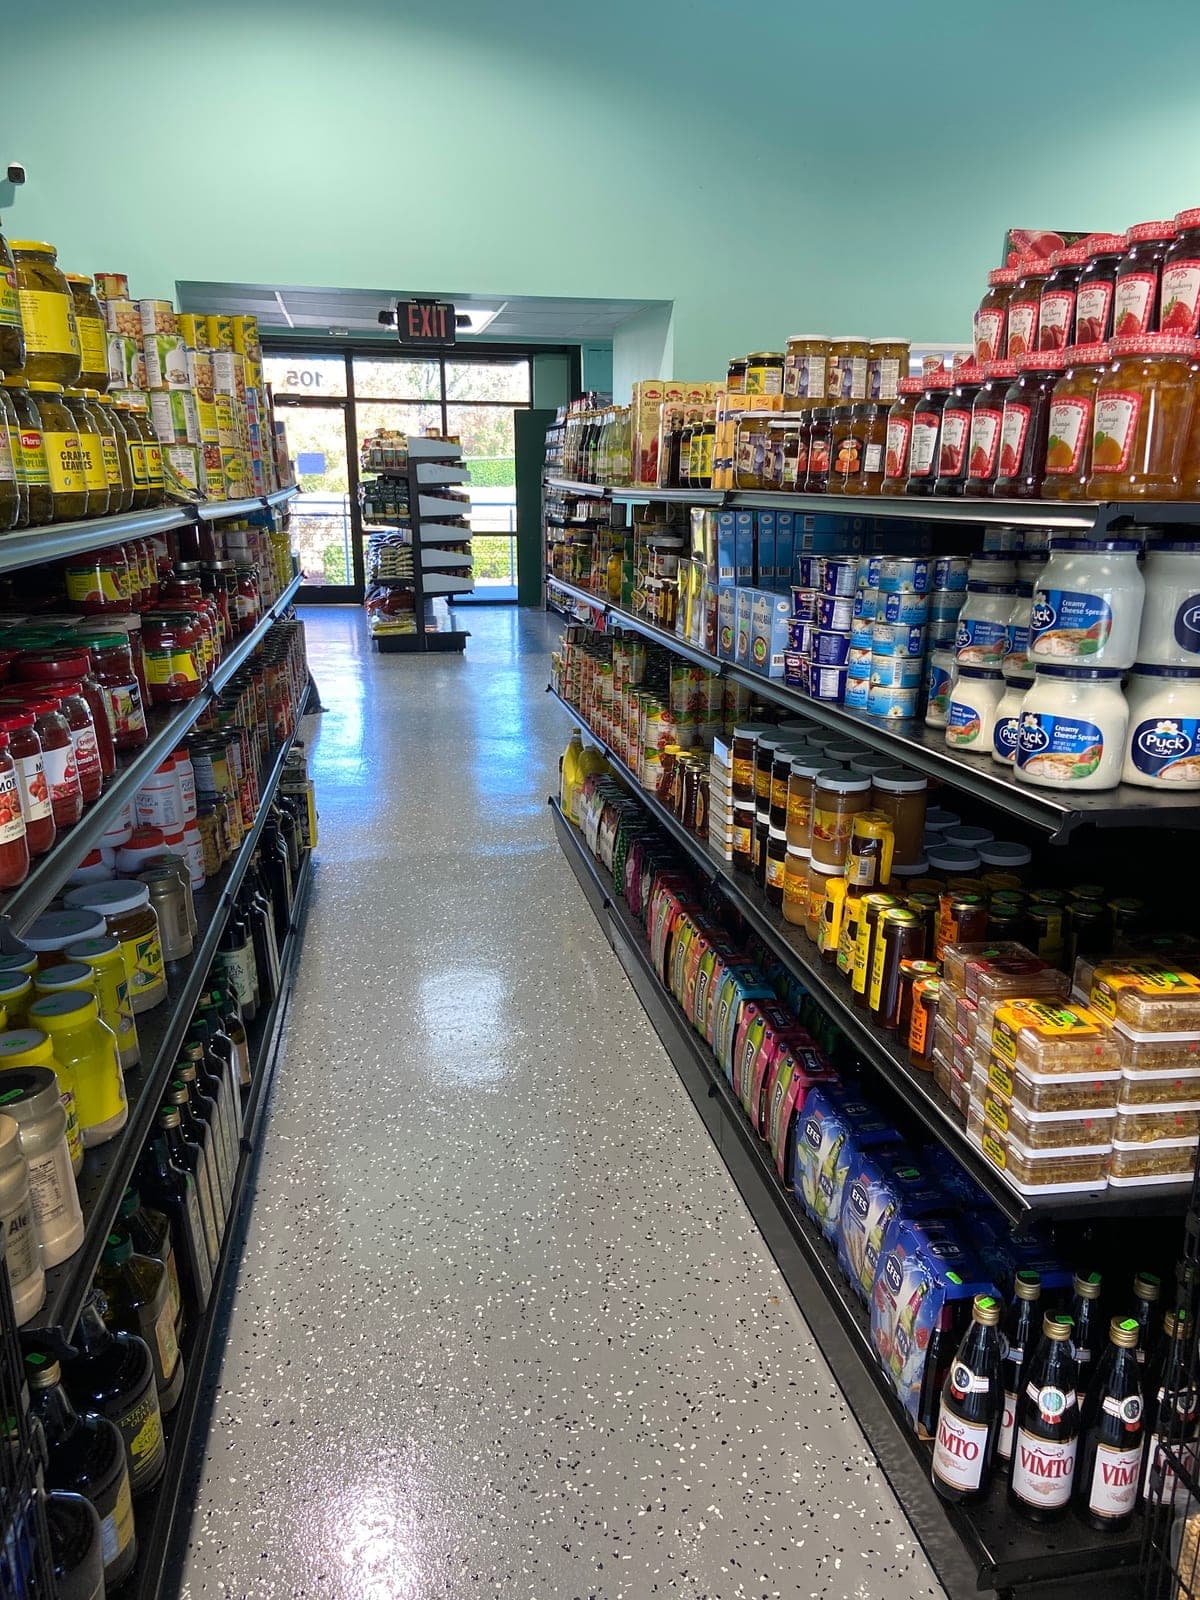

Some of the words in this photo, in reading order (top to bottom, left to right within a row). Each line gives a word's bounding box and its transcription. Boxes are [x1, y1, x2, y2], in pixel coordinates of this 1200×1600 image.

[407, 304, 448, 338] EXIT
[1061, 607, 1084, 615] Cheese
[1084, 608, 1109, 617] Spread
[1062, 599, 1087, 609] Creamy
[1054, 724, 1080, 734] Creamy
[1054, 732, 1079, 740] Cheese
[1078, 733, 1101, 742] Spread
[1145, 734, 1185, 750] Puck
[806, 1123, 821, 1144] EFES
[852, 1188, 868, 1212] EFES
[886, 1260, 901, 1288] EFES
[1020, 1444, 1074, 1479] VIMTO
[1102, 1462, 1138, 1487] VIM
